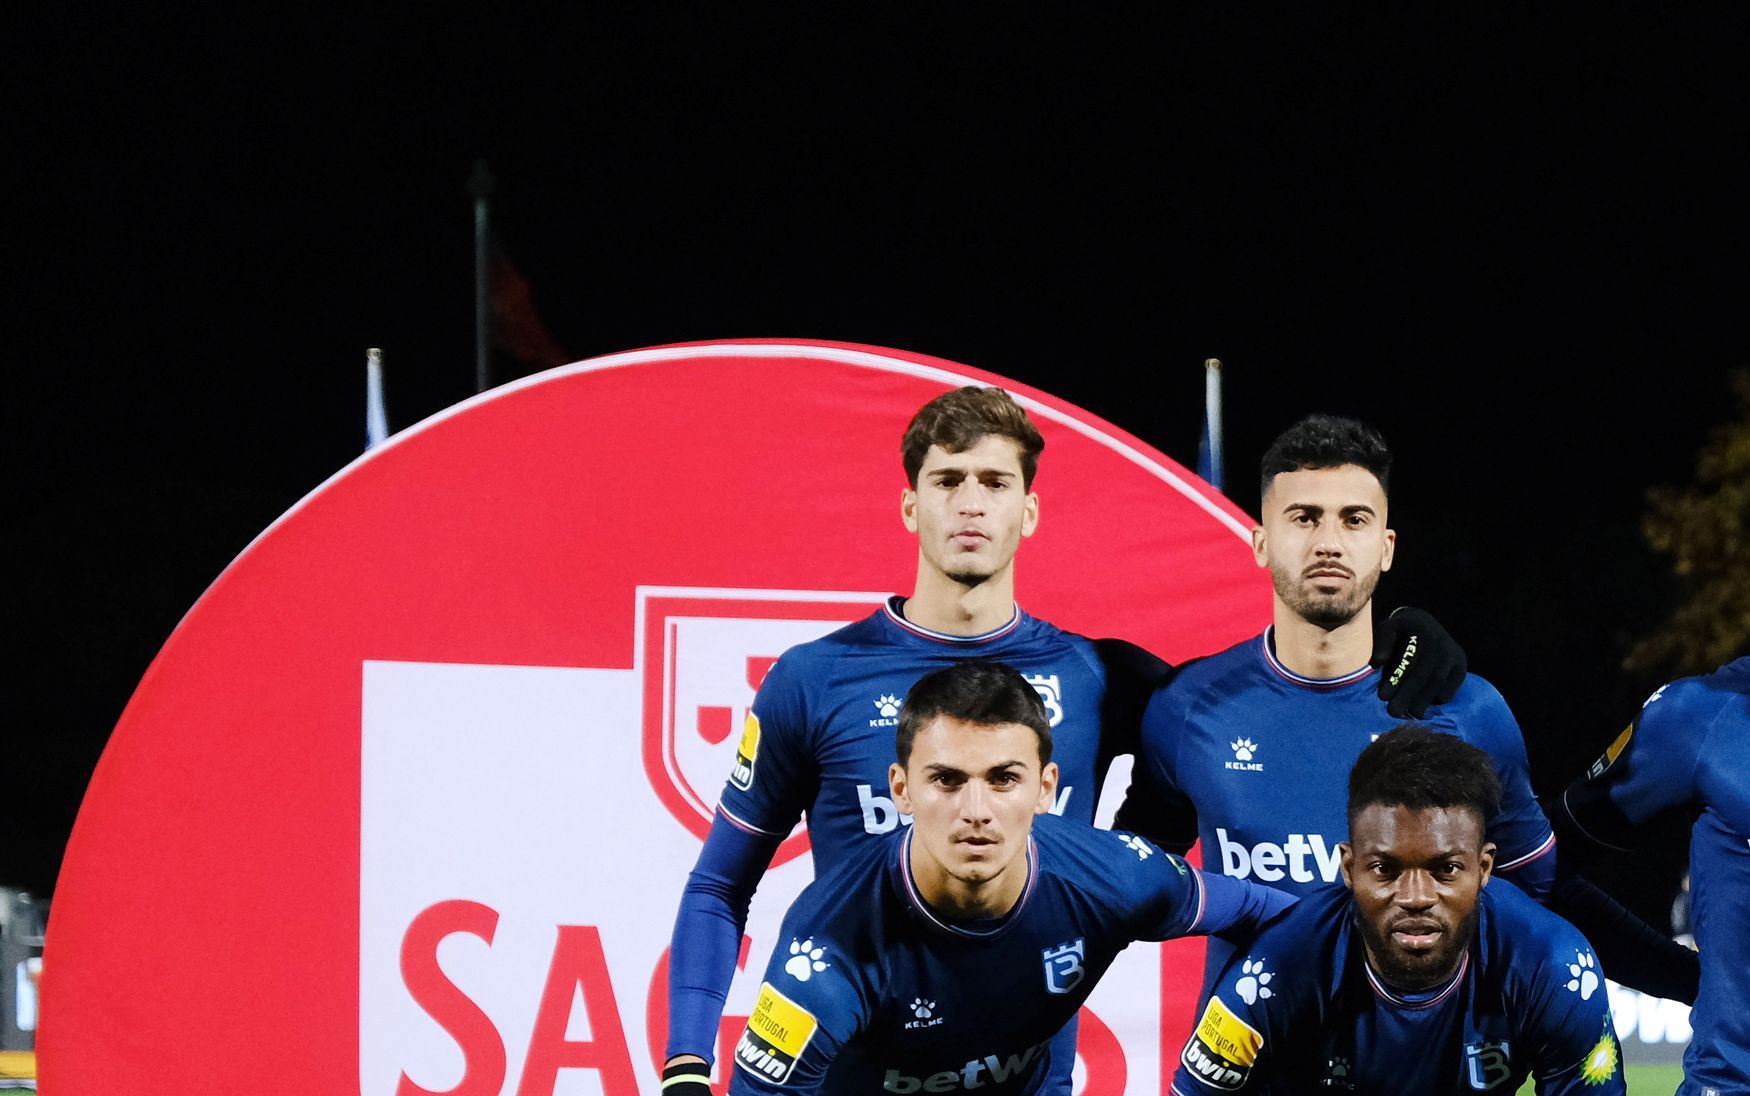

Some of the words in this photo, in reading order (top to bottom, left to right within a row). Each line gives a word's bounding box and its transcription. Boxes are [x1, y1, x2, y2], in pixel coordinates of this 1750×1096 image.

[1394, 635, 1418, 678] KELME
[1225, 761, 1263, 772] KELME
[757, 993, 774, 1012] LIGA
[904, 1017, 944, 1029] KELME
[1207, 1008, 1223, 1027] LIGA
[1202, 1020, 1239, 1057] PORTUGAL
[1186, 1039, 1242, 1085] bwin
